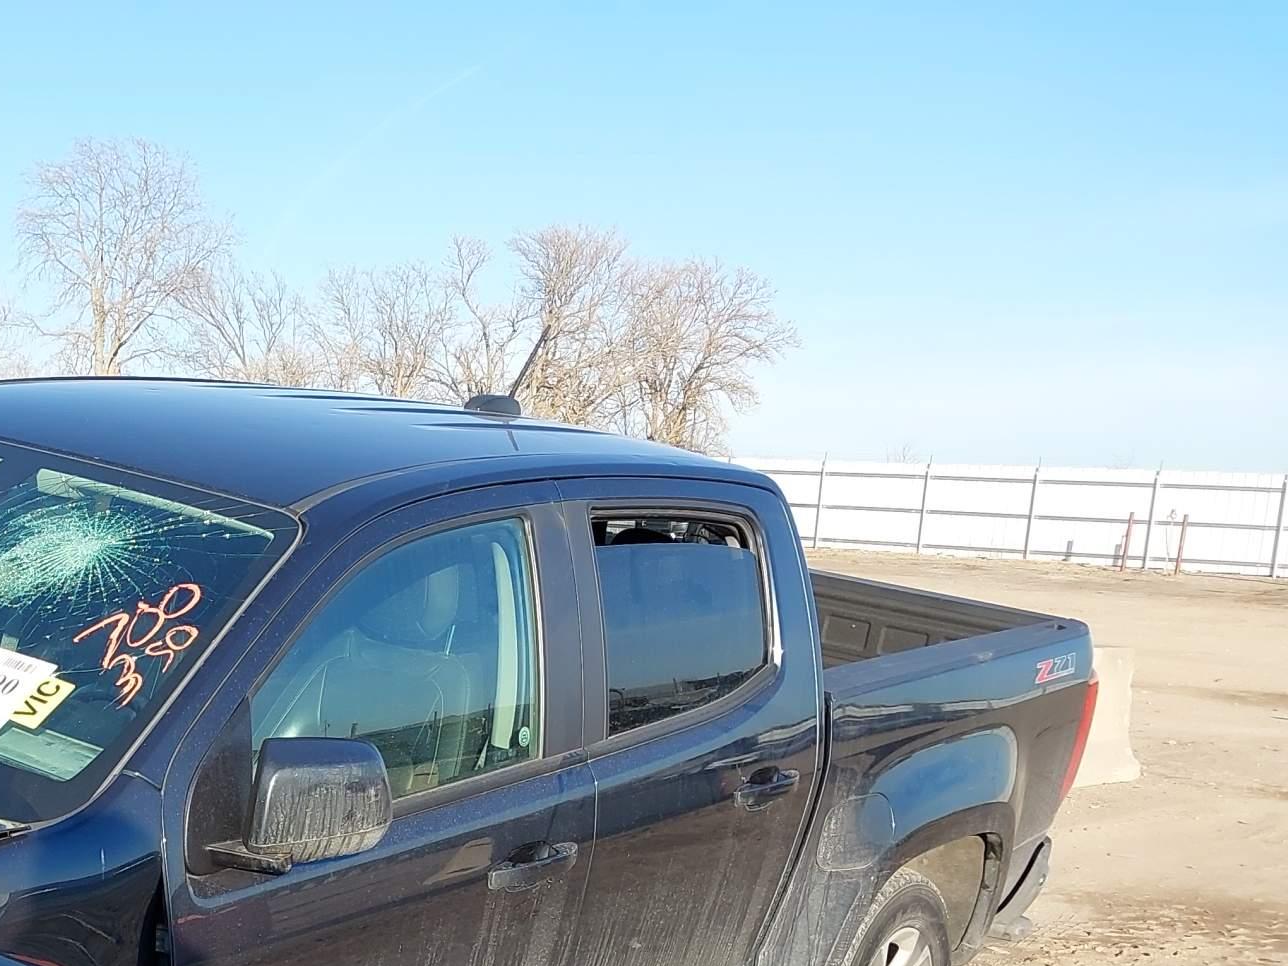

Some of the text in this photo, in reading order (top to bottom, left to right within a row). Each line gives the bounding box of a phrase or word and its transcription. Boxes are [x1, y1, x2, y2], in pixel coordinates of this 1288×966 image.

[72, 583, 202, 671] 700
[1034, 651, 1077, 685] Z71
[12, 680, 61, 716] VIC
